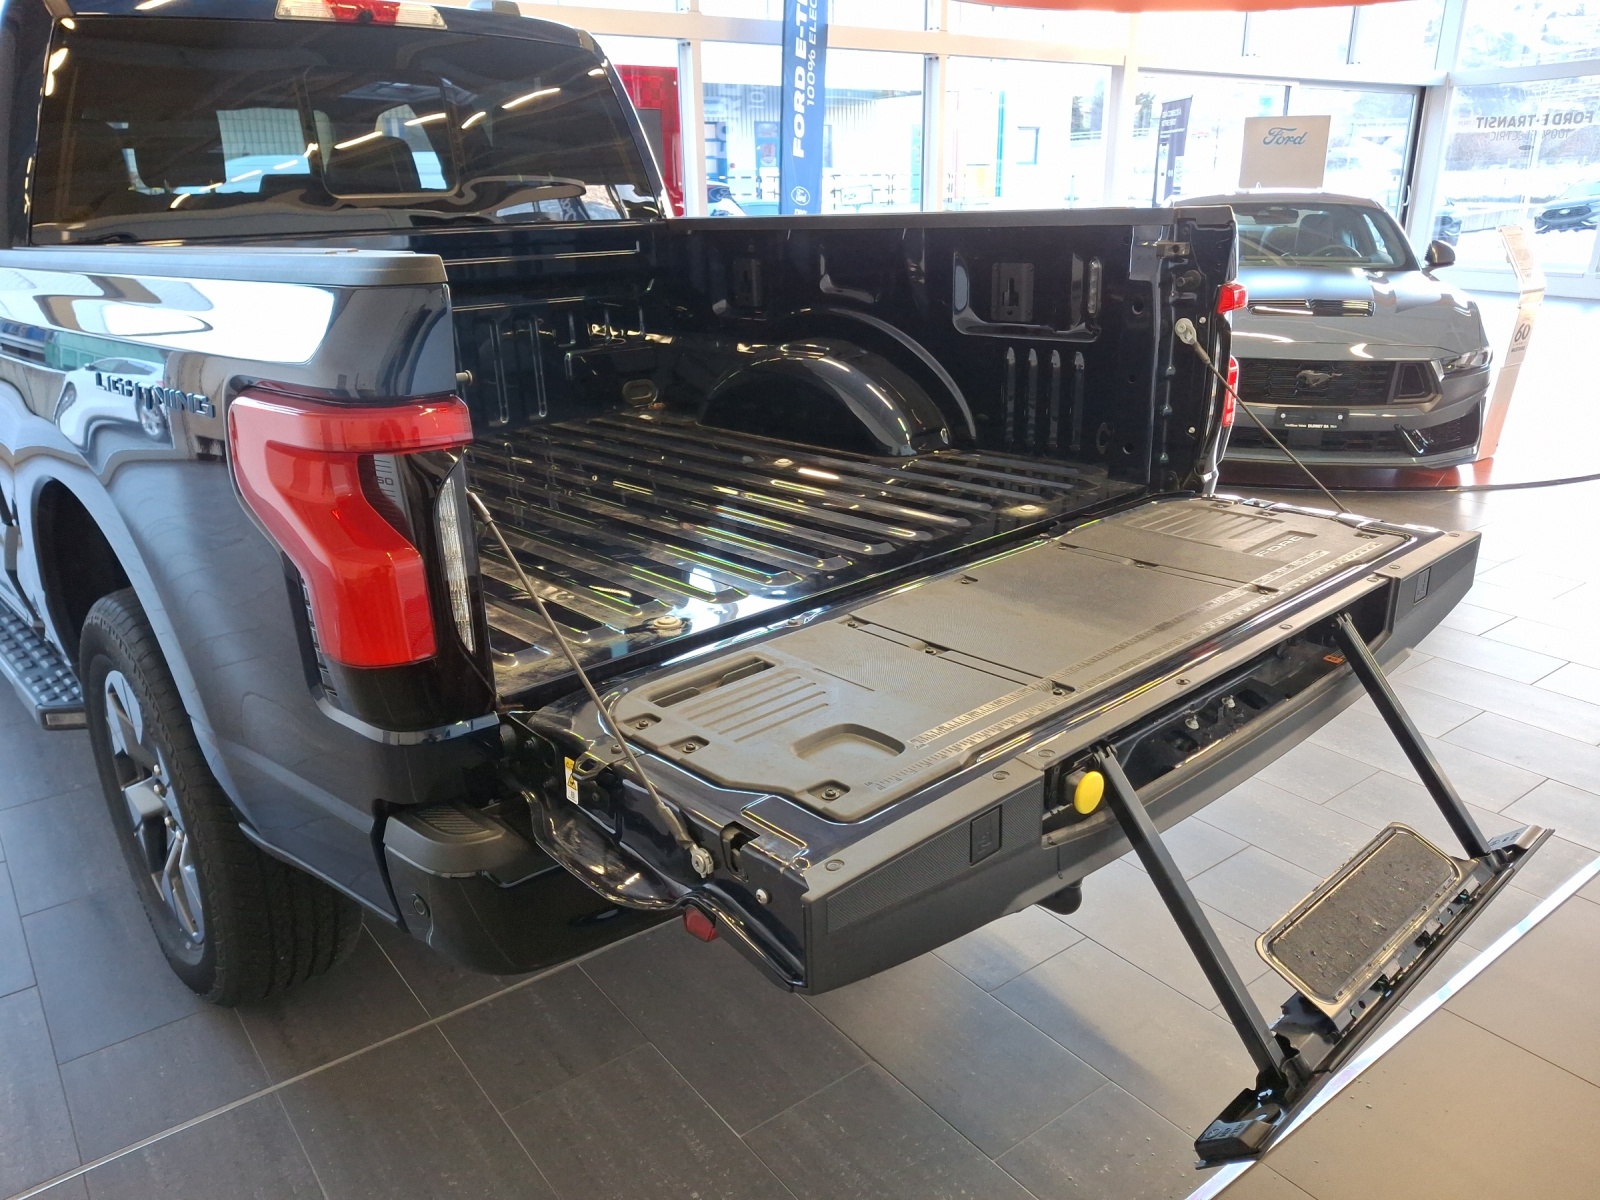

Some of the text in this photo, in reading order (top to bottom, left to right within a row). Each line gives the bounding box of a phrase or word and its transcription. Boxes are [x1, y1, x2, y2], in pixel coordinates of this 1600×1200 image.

[806, 49, 816, 106] 100%
[792, 65, 806, 158] FORD
[1263, 127, 1307, 145] Ford
[1514, 323, 1530, 342] 60
[95, 372, 216, 418] LIGHTNING
